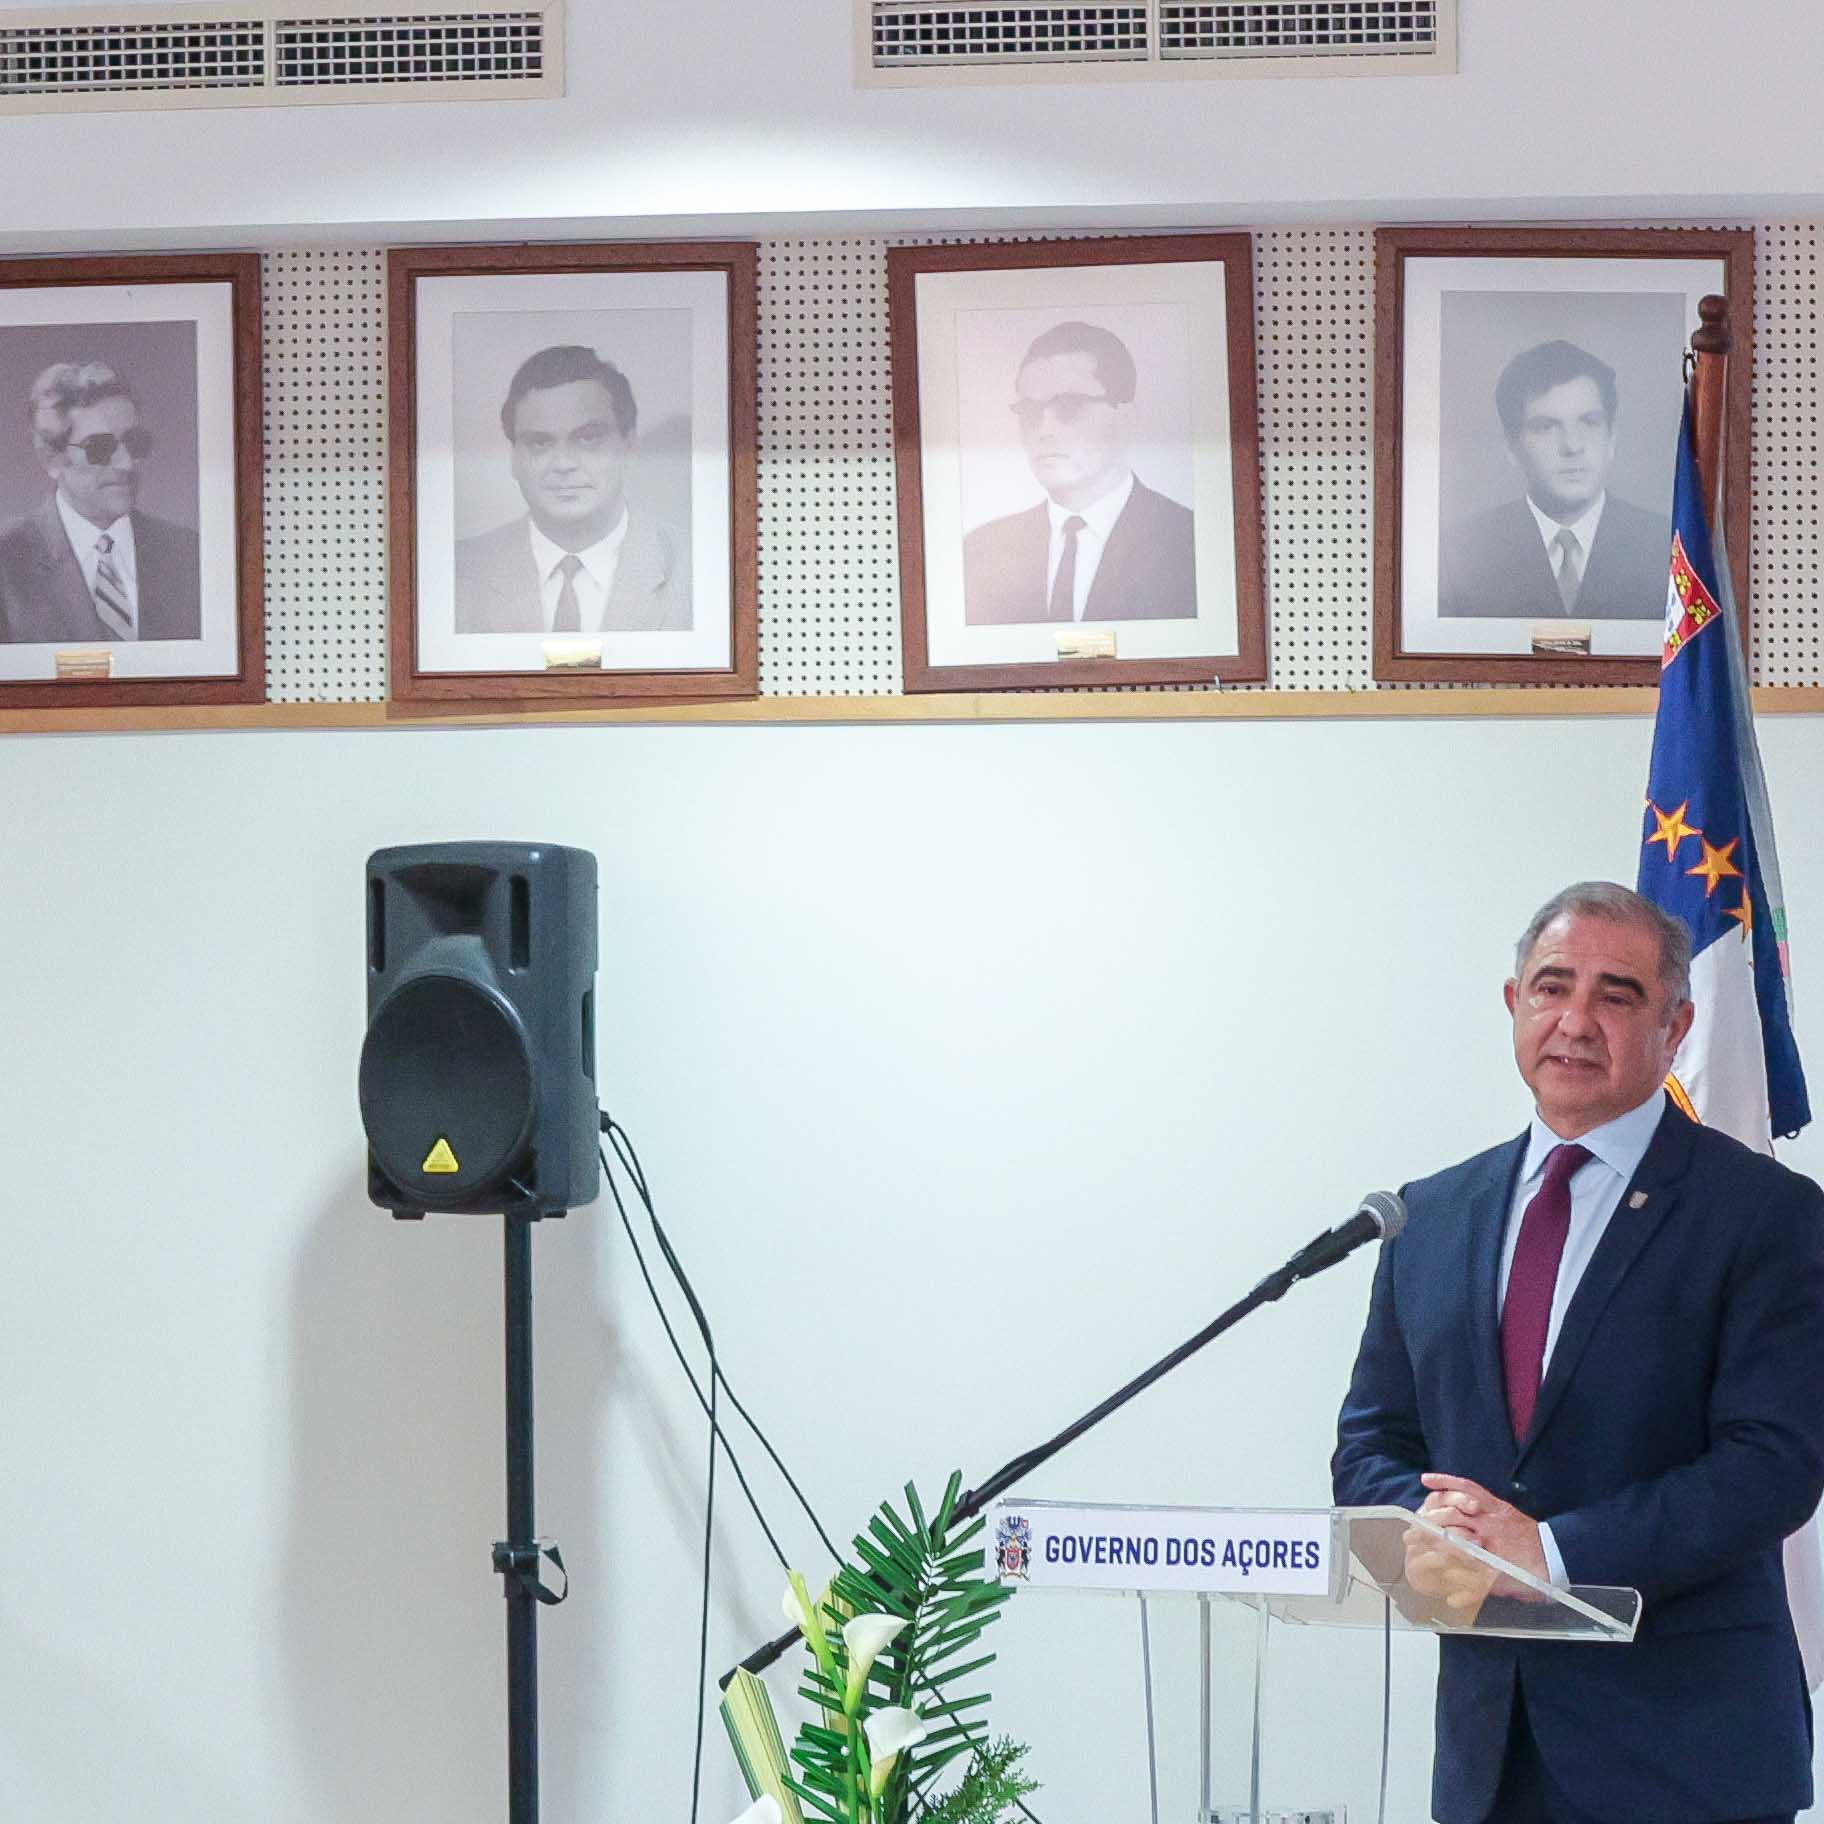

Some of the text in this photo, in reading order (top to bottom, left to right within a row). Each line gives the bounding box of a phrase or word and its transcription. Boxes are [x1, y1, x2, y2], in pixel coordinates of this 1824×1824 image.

[1045, 1535, 1321, 1576] GOVERNO DOS AÇORES
